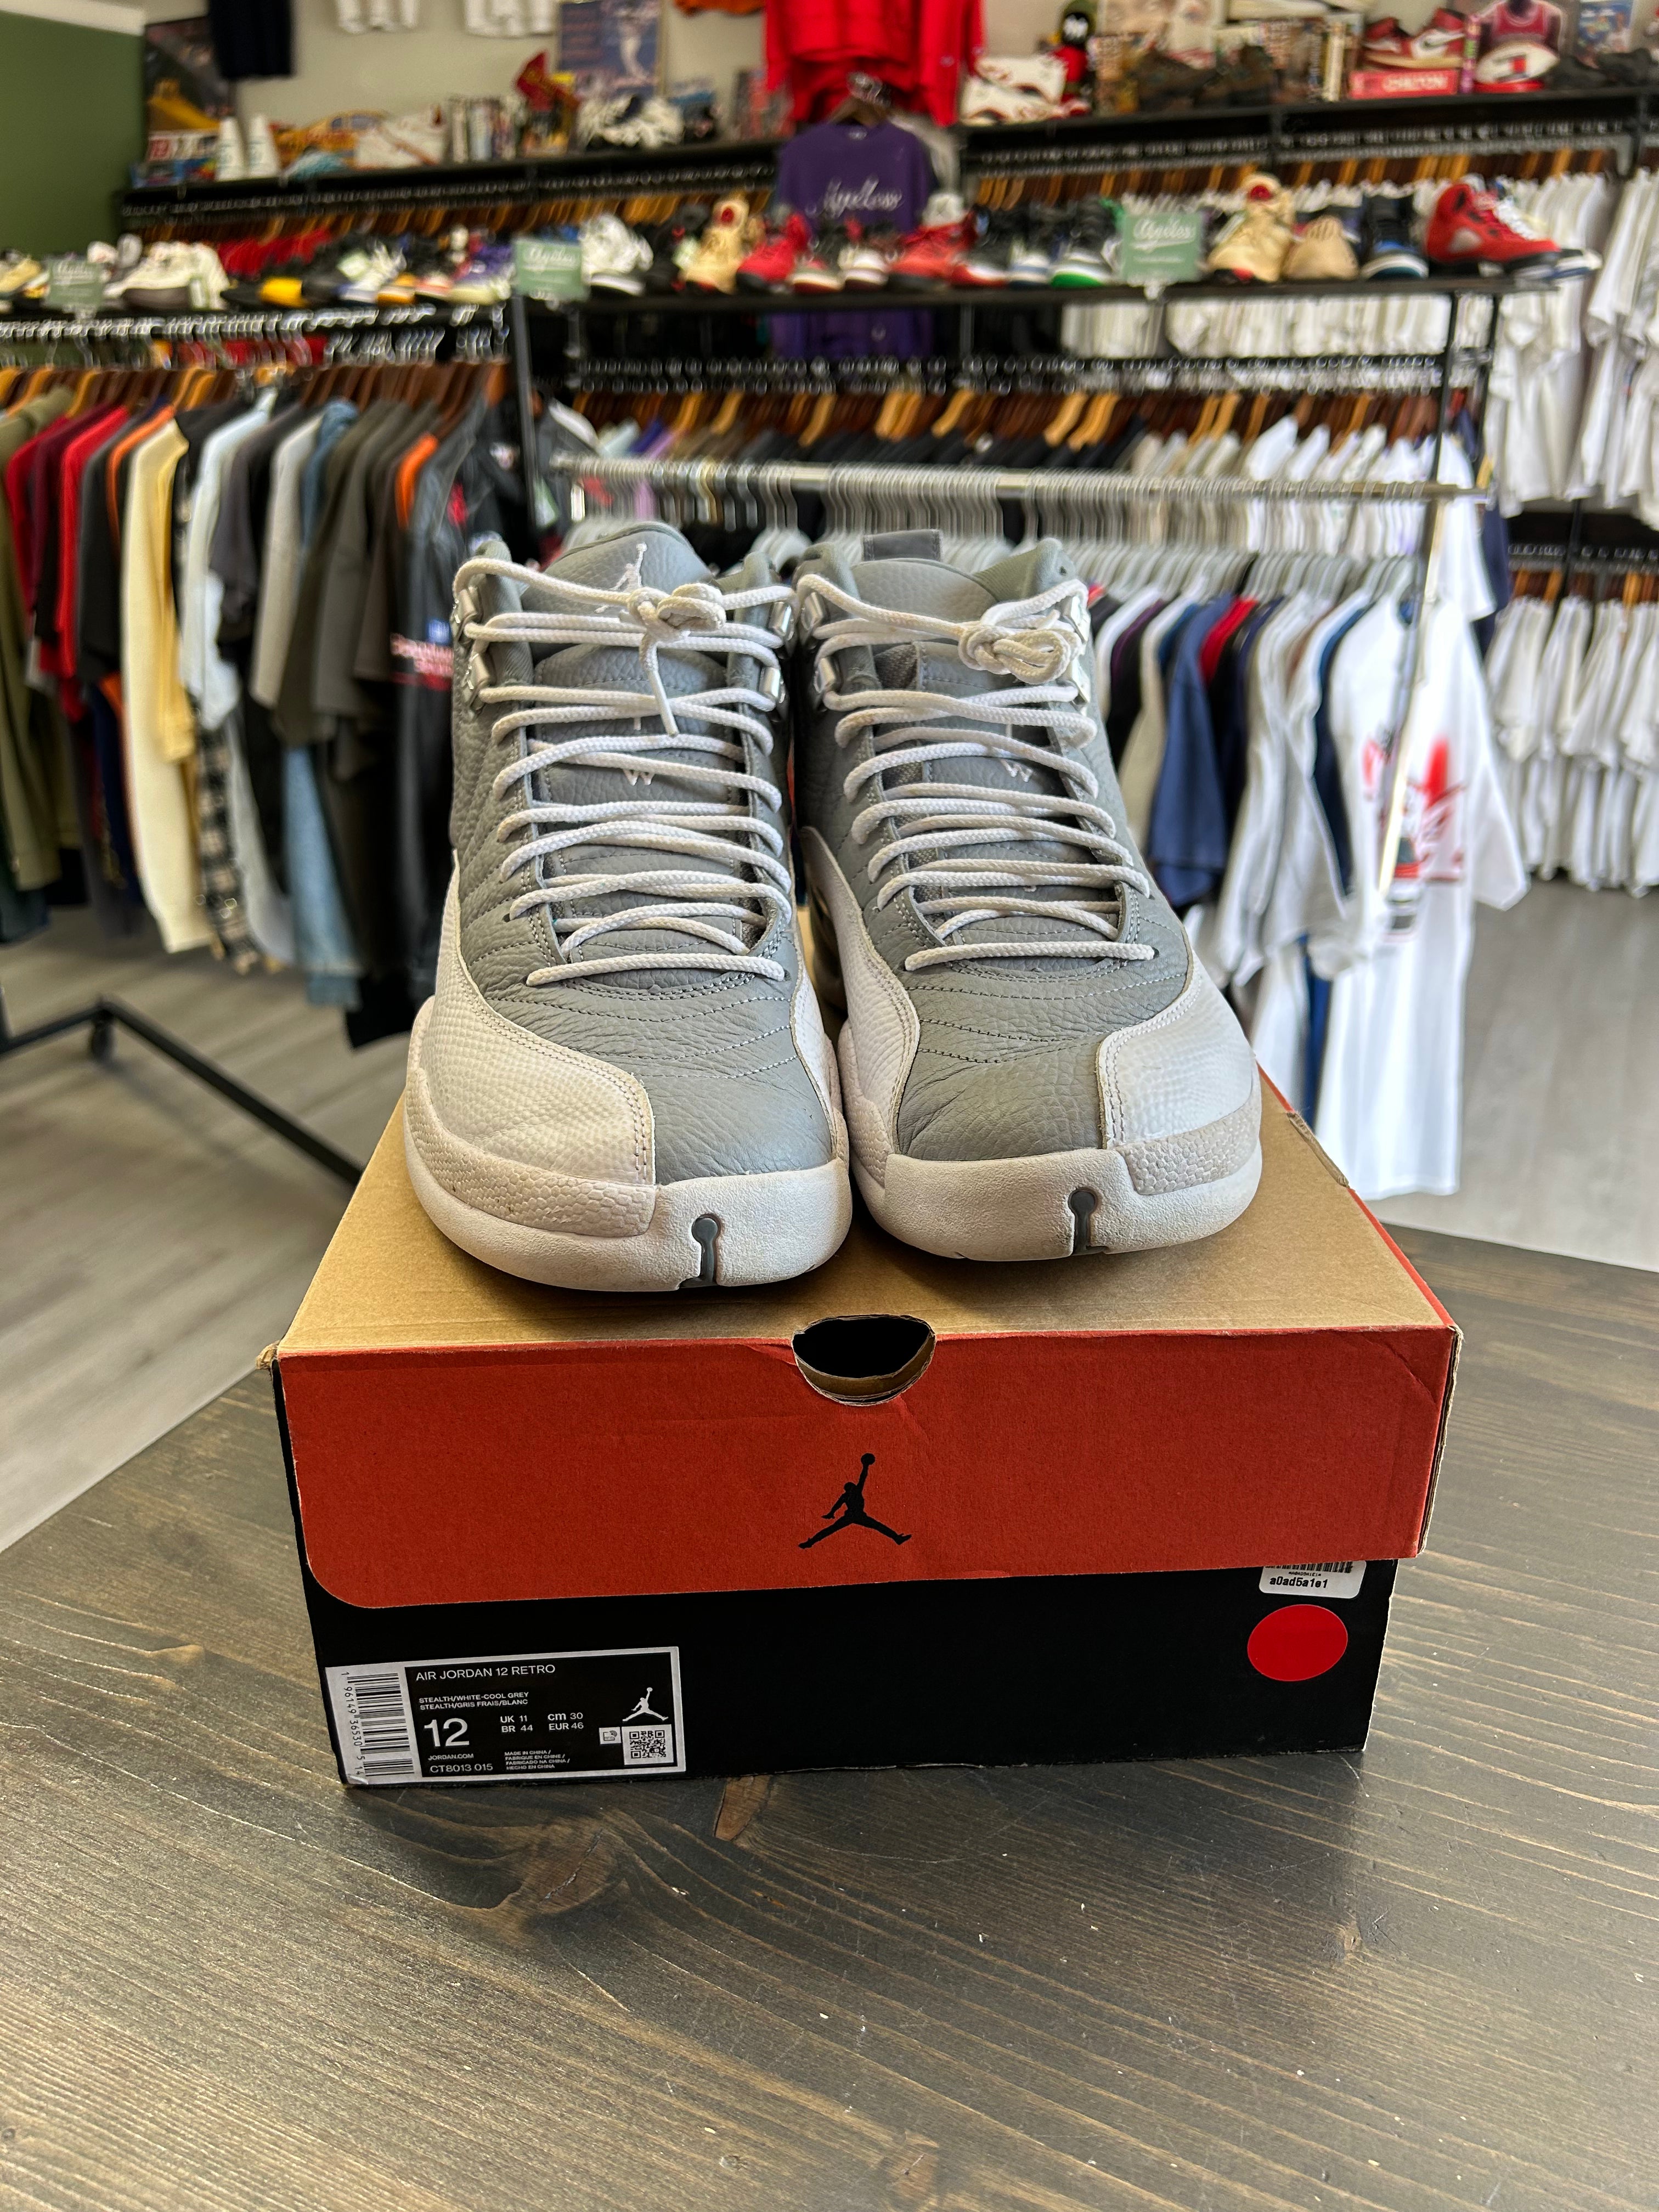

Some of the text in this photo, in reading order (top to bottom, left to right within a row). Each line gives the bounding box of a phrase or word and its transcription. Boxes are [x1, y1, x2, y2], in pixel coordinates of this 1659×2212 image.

[1269, 1576, 1328, 1588] a0ad5a1e1
[415, 1664, 555, 1681] AIR JORDAN 12 RETRO
[343, 1686, 357, 1714] 96149
[419, 1692, 507, 1703] STEALTH/WHITE-COOL
[420, 1699, 528, 1711] STEALTH/GRIS FRAIS/BLANC
[500, 1715, 515, 1723] UK
[547, 1713, 566, 1721] cm
[424, 1718, 470, 1747] 12
[501, 1725, 516, 1733] BR
[549, 1723, 569, 1731] EUR
[349, 1720, 363, 1746] 36530
[430, 1763, 493, 1773] CT8013 015
